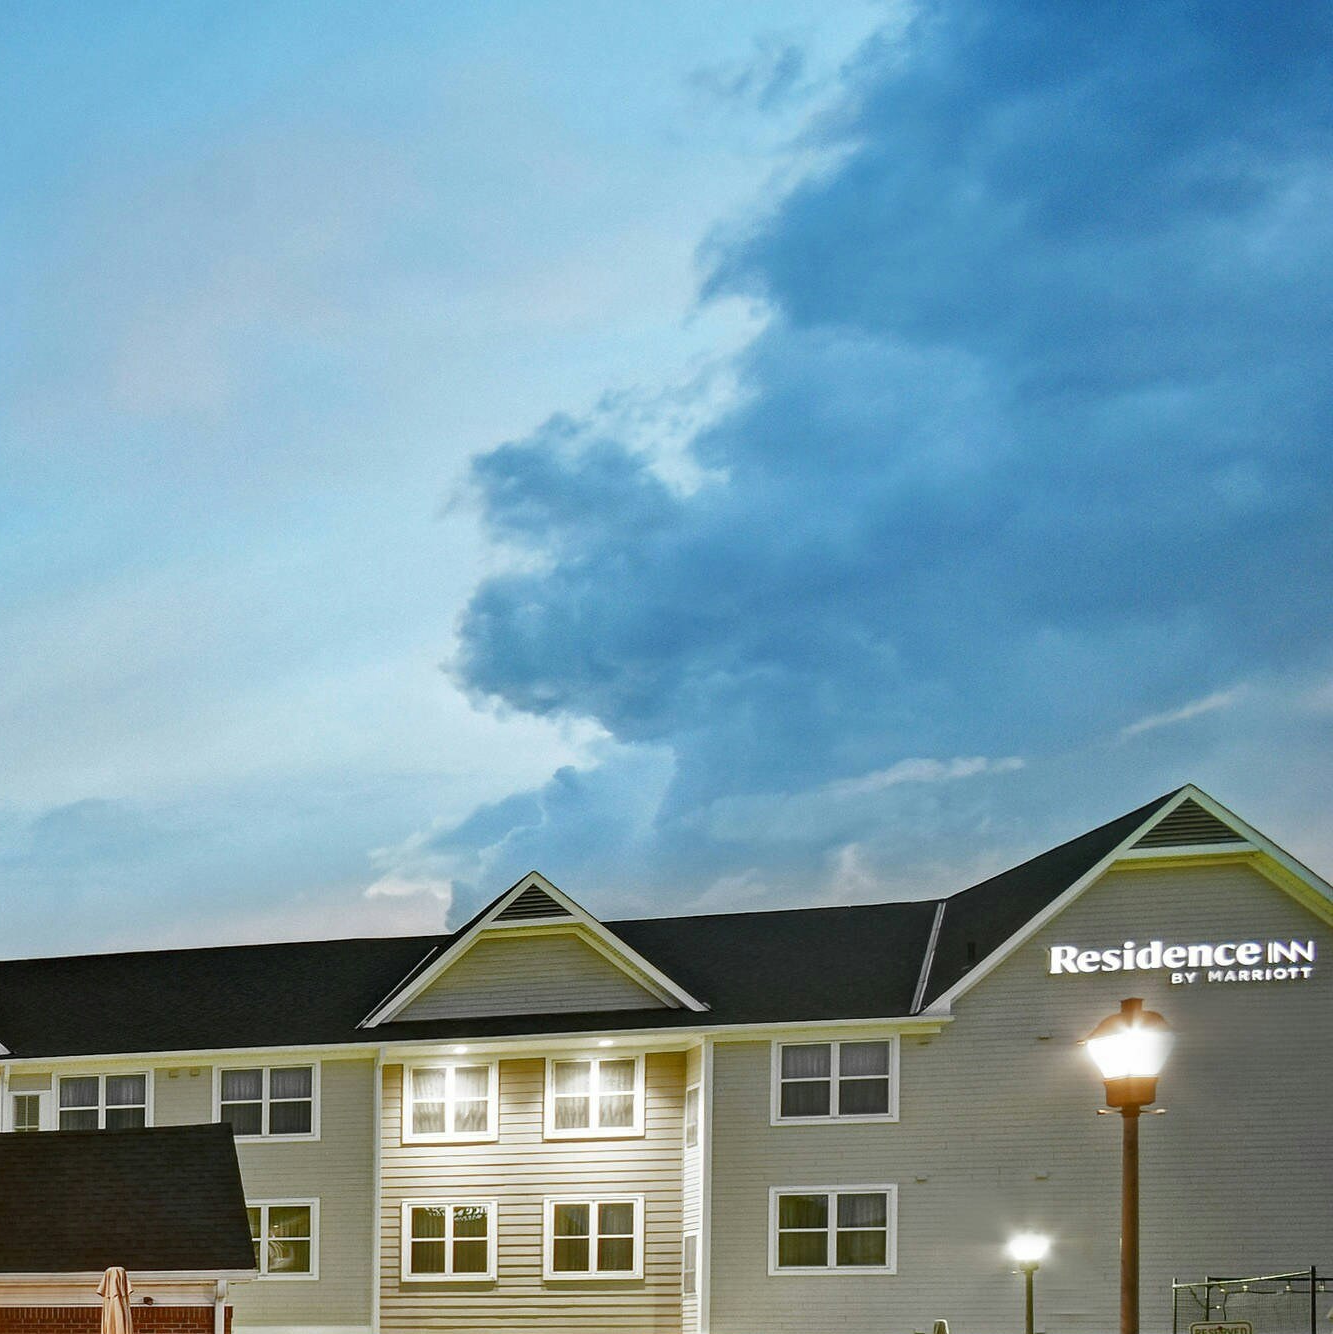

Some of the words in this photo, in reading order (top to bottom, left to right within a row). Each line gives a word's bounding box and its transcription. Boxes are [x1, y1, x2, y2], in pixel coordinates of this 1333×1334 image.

[1049, 941, 1262, 975] Residence
[1268, 940, 1314, 964] INN
[1170, 971, 1197, 985] BY
[1208, 967, 1314, 983] MARRIOTT
